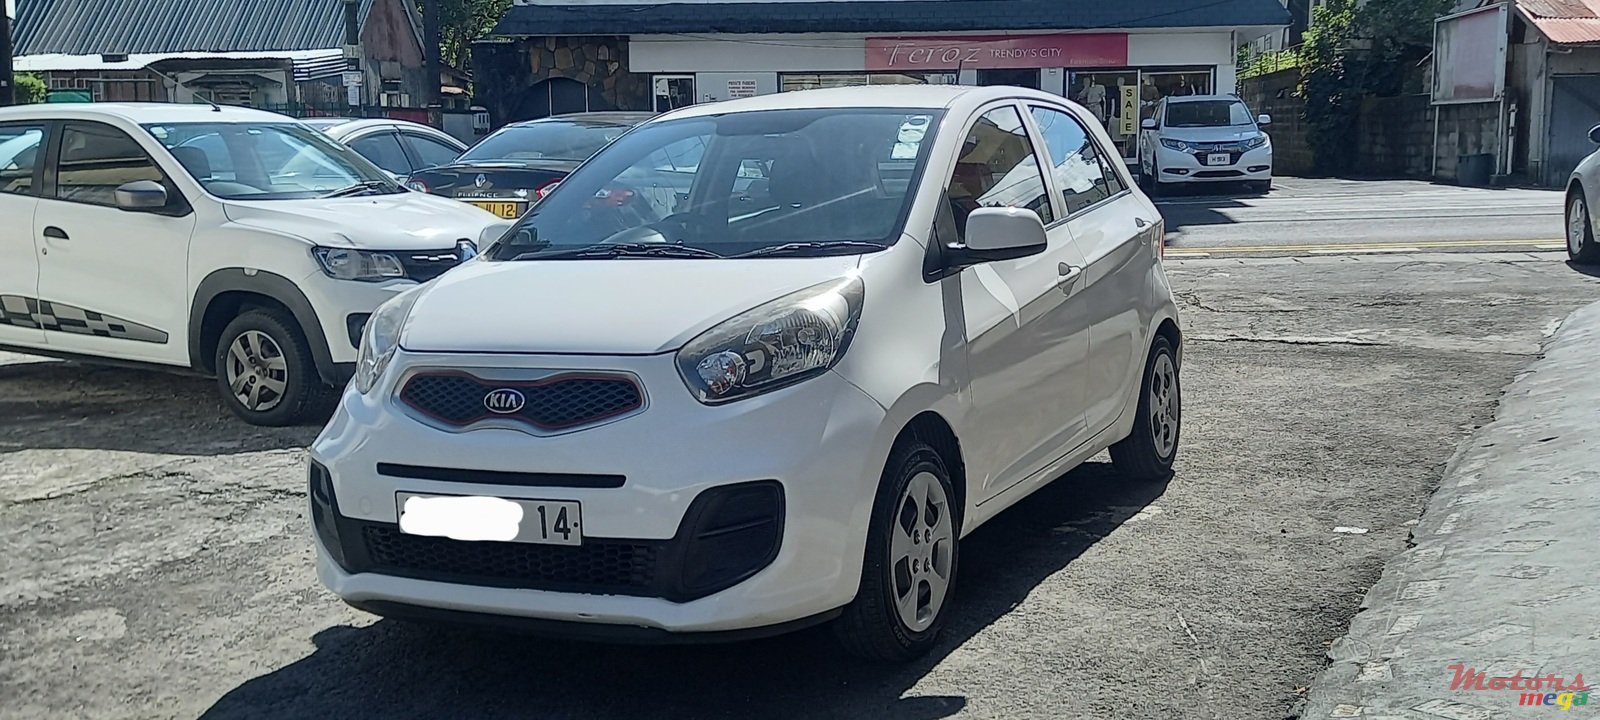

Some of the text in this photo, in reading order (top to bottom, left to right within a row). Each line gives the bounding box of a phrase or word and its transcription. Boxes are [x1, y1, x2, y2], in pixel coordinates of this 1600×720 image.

[886, 42, 982, 67] Feroz
[990, 47, 1062, 59] TRENDY'S CITY
[1125, 88, 1133, 132] SALE
[501, 203, 514, 217] 12
[489, 393, 518, 408] KIA
[537, 505, 571, 540] 14
